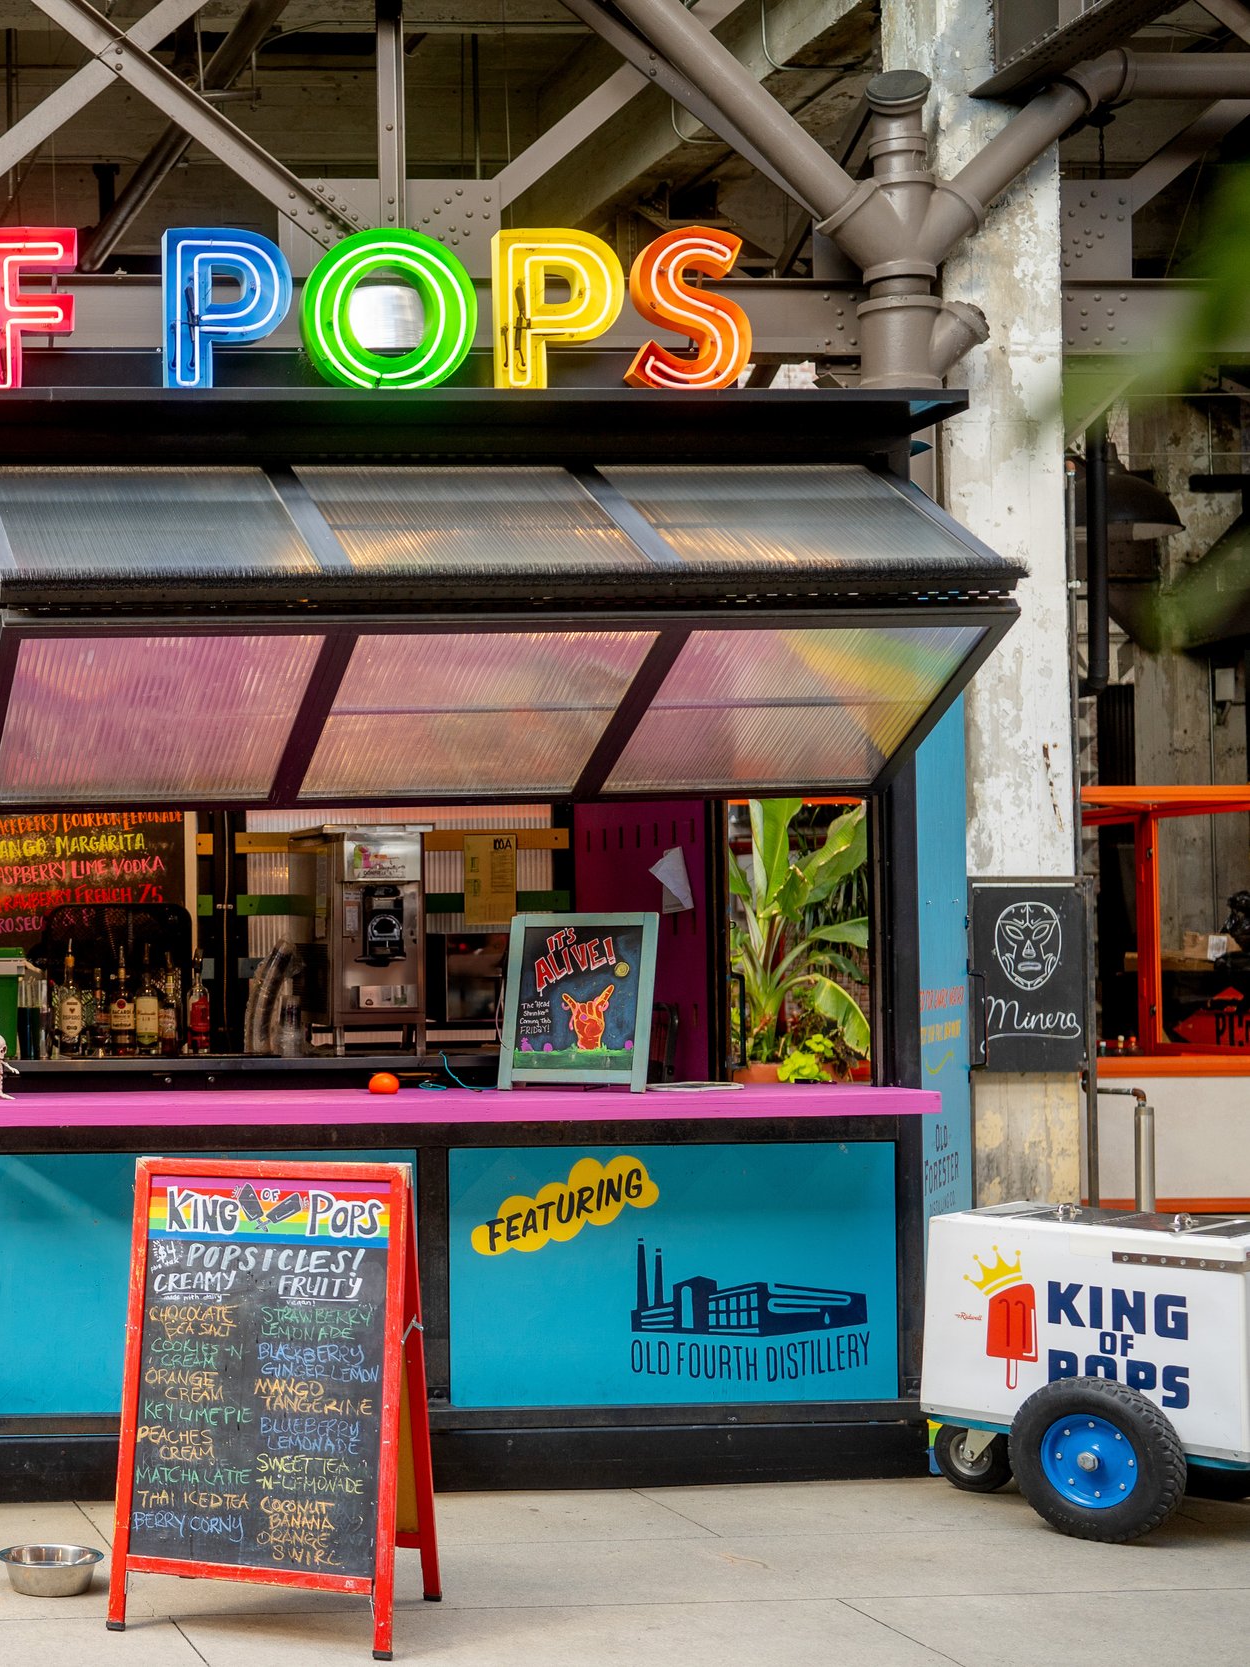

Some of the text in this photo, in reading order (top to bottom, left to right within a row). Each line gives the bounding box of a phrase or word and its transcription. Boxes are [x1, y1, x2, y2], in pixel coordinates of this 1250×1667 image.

[162, 226, 752, 389] POPS
[61, 812, 123, 833] BOURBON
[123, 811, 183, 831] LEMONADE
[55, 833, 146, 857] MARGARITA
[70, 858, 108, 880] LIME
[111, 855, 165, 876] VODKA
[73, 883, 133, 904] FRENCH
[138, 883, 164, 904] 75
[546, 927, 577, 951] IT'S
[535, 937, 616, 993] ALIVE!
[520, 1018, 539, 1027] Coming
[935, 1123, 948, 1152] OLD
[924, 1151, 959, 1196] FORESTER
[167, 1185, 385, 1238] KING OF POPS
[486, 1169, 643, 1252] FEATURING
[164, 1257, 180, 1266] tax
[187, 1243, 365, 1277] POPSICLES!
[153, 1270, 237, 1293] CREAMY
[278, 1275, 363, 1298] FRUITY
[149, 1305, 239, 1323] CHOCOLATE
[261, 1305, 372, 1327] STRAWBERRY
[1047, 1280, 1189, 1340] KING
[198, 1322, 237, 1337] SALT
[261, 1322, 355, 1341] LEMONADE
[151, 1337, 219, 1355] COOKIES
[257, 1342, 365, 1365] BLACKBERRY
[1099, 1331, 1134, 1357] OF
[161, 1354, 217, 1370] CREAM
[630, 1331, 870, 1382] OLD FOURTH DISTILLERY
[145, 1367, 219, 1388] ORANGE
[261, 1362, 379, 1383] GINGER LEMON
[164, 1386, 224, 1403] CREAM
[254, 1378, 325, 1396] MANGO
[144, 1398, 253, 1426] KEY LIME PIE
[259, 1396, 373, 1416] TANGERINE
[136, 1425, 213, 1446] PEACHES
[260, 1416, 359, 1439] BLUEBERRY
[159, 1444, 214, 1462] CREAM
[267, 1436, 361, 1455] LEMONADE
[256, 1453, 350, 1474] SWEET TEA
[136, 1465, 252, 1486] MATCHA LATTE
[137, 1489, 250, 1510] THAI ICED TEA
[260, 1496, 335, 1515] COCONUT
[132, 1510, 244, 1543] BERRY CORNY
[269, 1513, 335, 1531] BANANA
[256, 1529, 331, 1550] ORANGE
[273, 1545, 344, 1566] SWIRL
